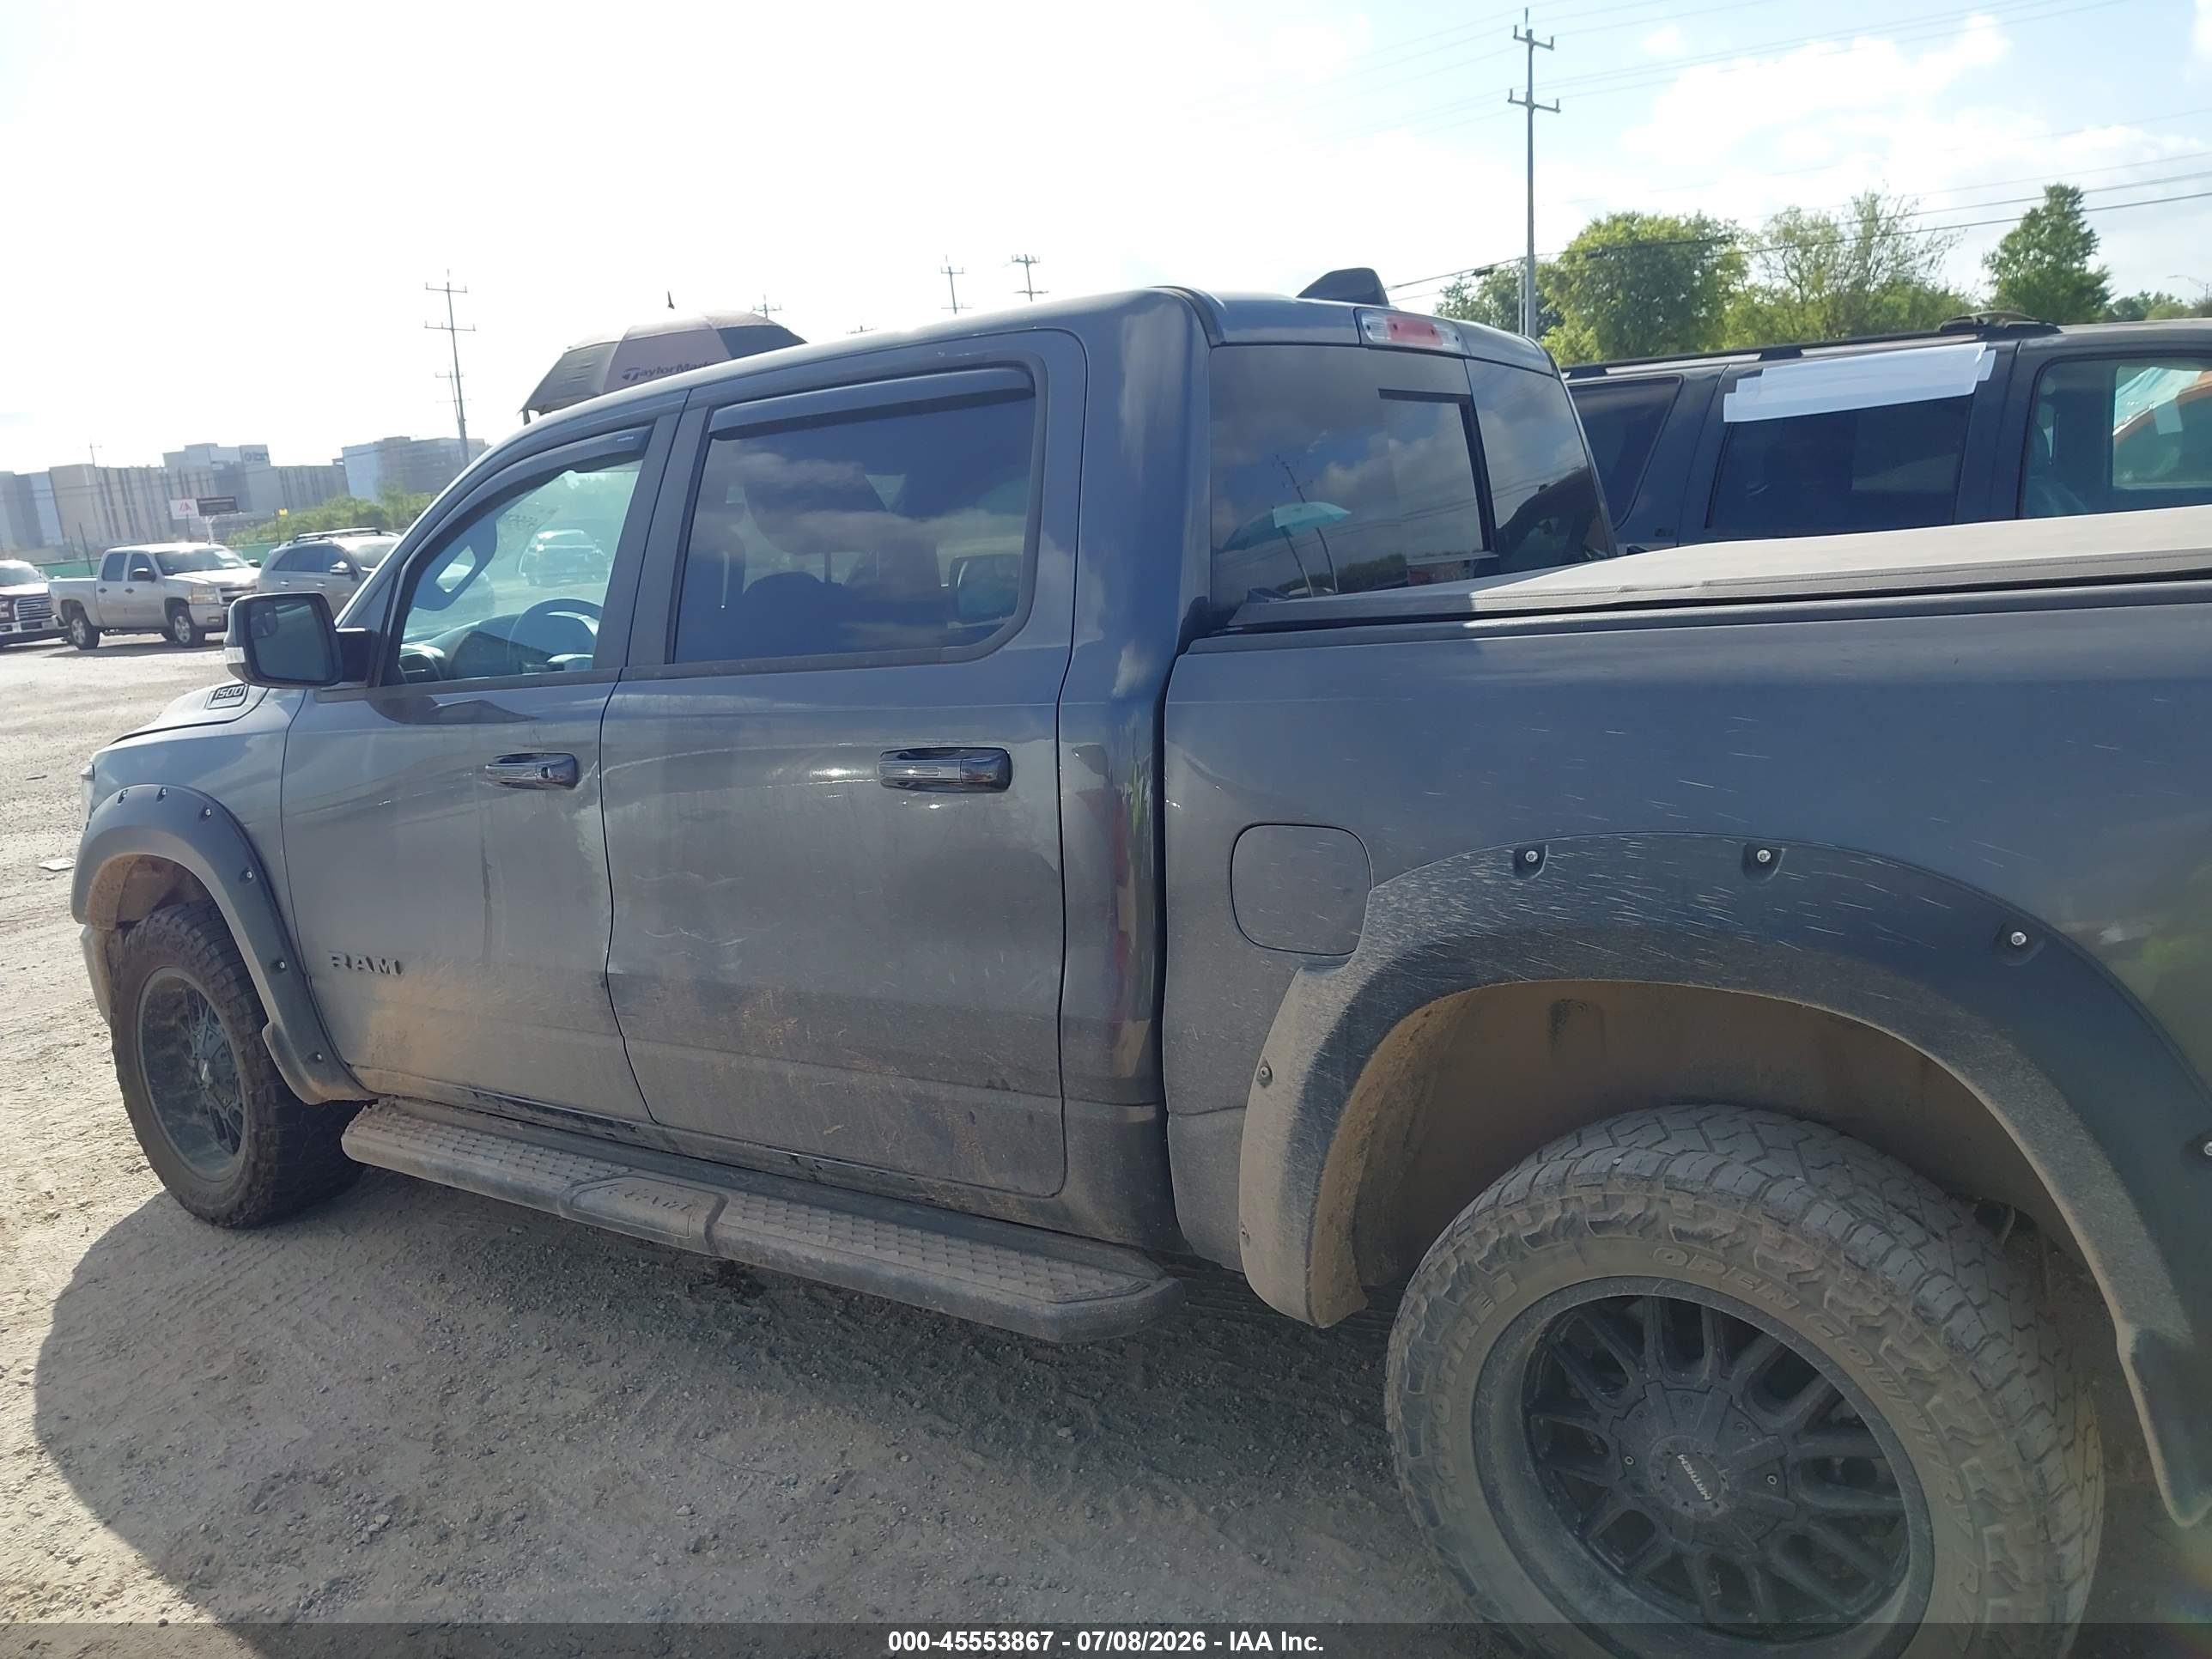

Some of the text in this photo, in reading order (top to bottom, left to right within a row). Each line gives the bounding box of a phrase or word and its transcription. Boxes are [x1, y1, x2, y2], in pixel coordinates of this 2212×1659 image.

[215, 686, 243, 699] 1500
[327, 951, 405, 976] RAM
[1651, 1246, 1802, 1310] OPEN
[1435, 1270, 1519, 1388] TIRES
[1677, 1454, 1711, 1501] MAYHEM
